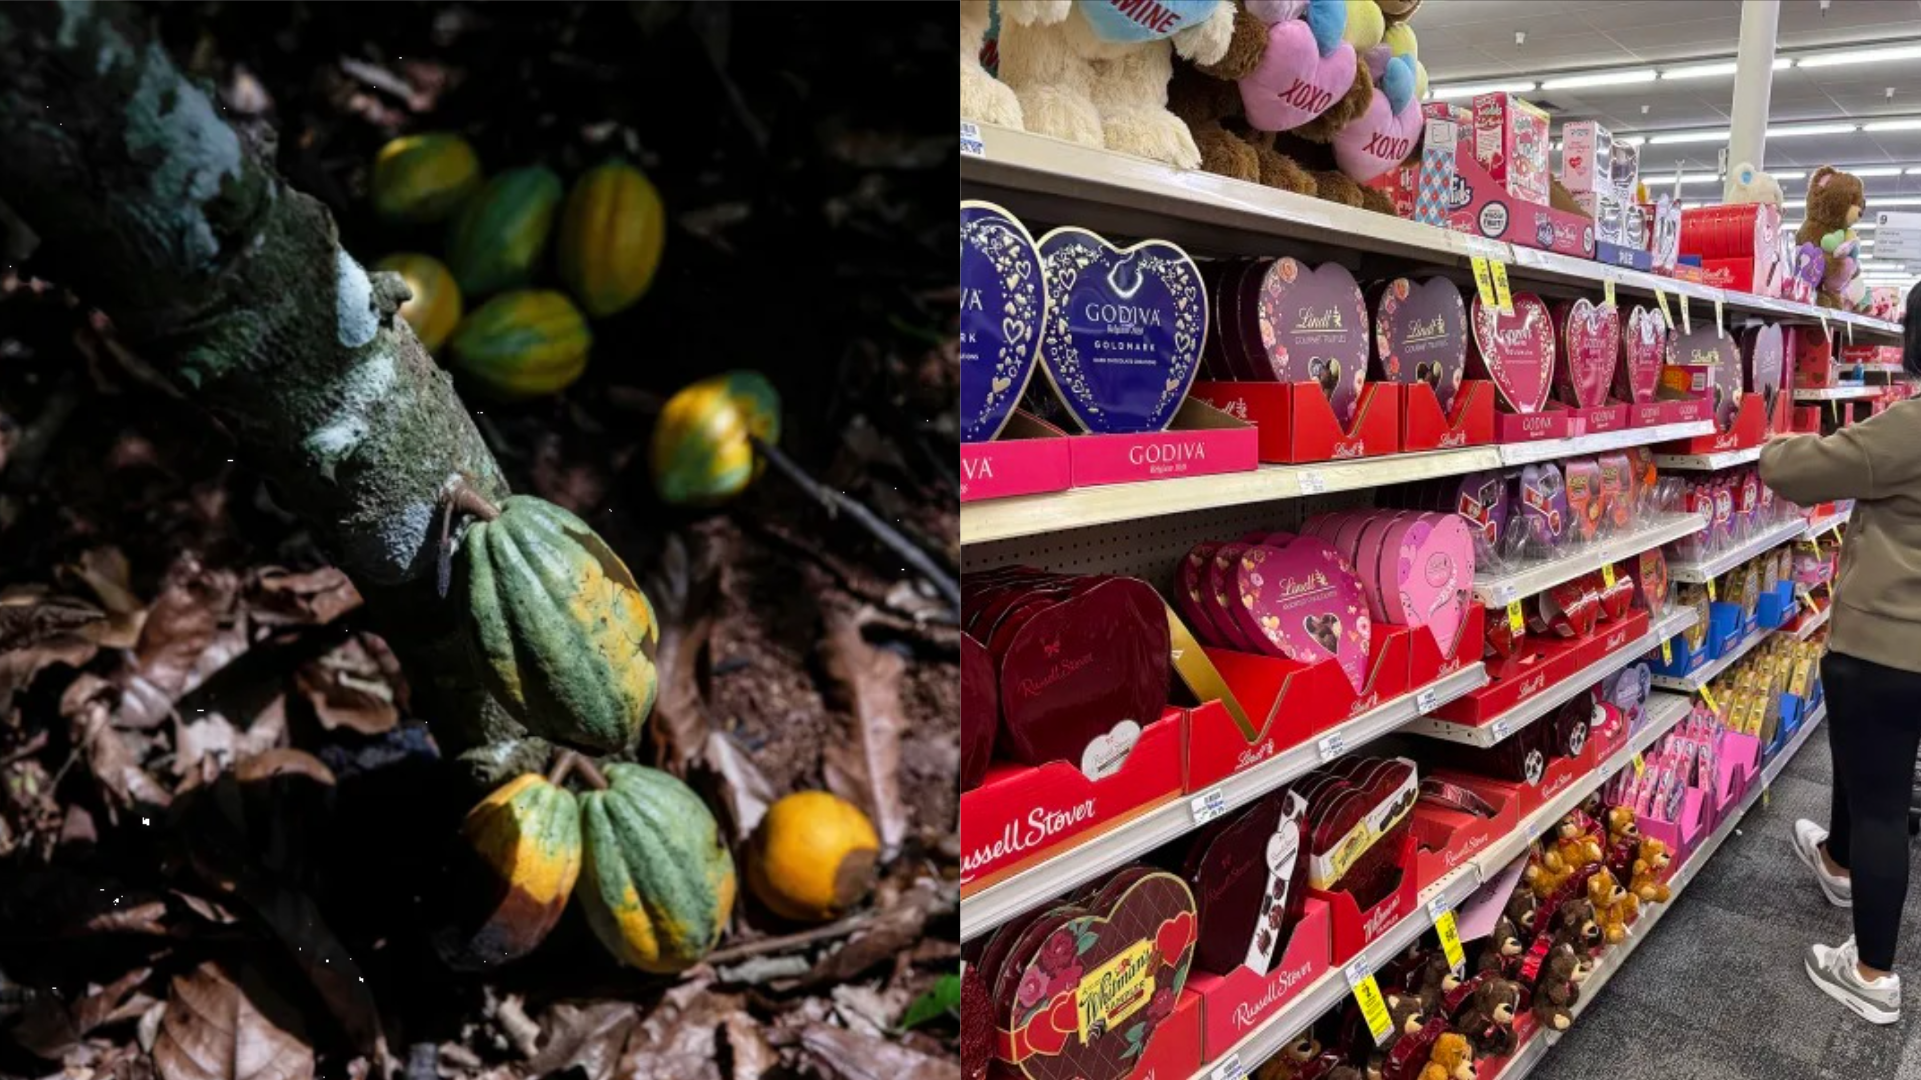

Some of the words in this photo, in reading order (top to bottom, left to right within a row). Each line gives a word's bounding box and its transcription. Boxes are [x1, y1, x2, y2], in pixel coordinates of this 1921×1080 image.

[1278, 79, 1334, 114] XOXO
[1362, 132, 1410, 161] XOXO
[1879, 214, 1888, 225] 9
[1085, 303, 1160, 327] GODIVA
[1294, 306, 1333, 330] Lindt
[1129, 443, 1206, 465] GODIVA
[1279, 573, 1316, 596] Lindt
[961, 818, 1025, 884] ussell
[1024, 797, 1096, 847] Stover
[1079, 949, 1150, 1026] Whitman's
[1232, 980, 1280, 1031] Russell
